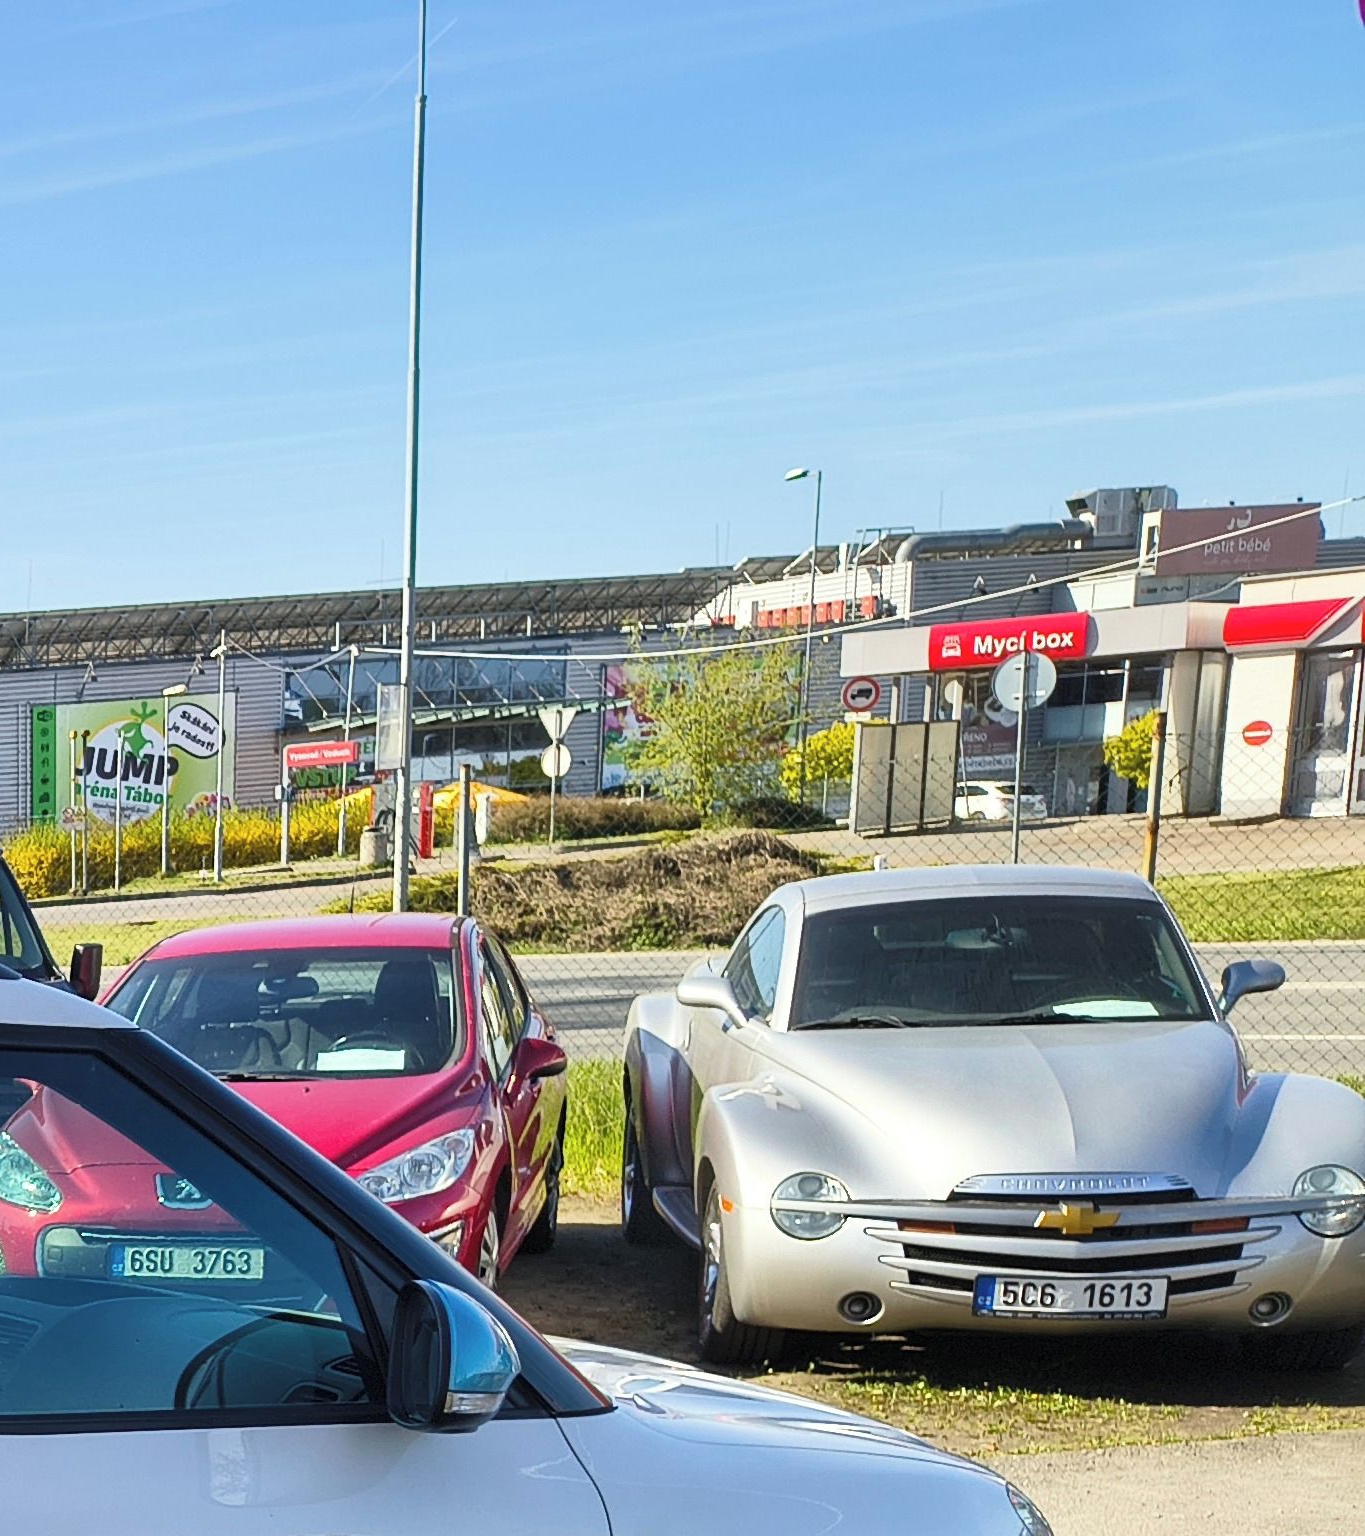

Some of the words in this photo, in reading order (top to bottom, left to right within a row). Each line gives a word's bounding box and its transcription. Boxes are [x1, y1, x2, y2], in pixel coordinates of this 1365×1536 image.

[1204, 539, 1234, 556] petit
[1239, 537, 1271, 553] bébé
[973, 630, 1027, 658] Mycí
[1032, 631, 1074, 650] box
[169, 722, 180, 733] je
[75, 746, 179, 786] JUMP
[295, 764, 357, 788] VSTUP
[1000, 1175, 1151, 1191] CHEVROLET
[130, 1248, 173, 1274] 6SU
[192, 1249, 252, 1275] 3763
[1001, 1281, 1056, 1307] 5C6
[1083, 1282, 1153, 1308] 1613
